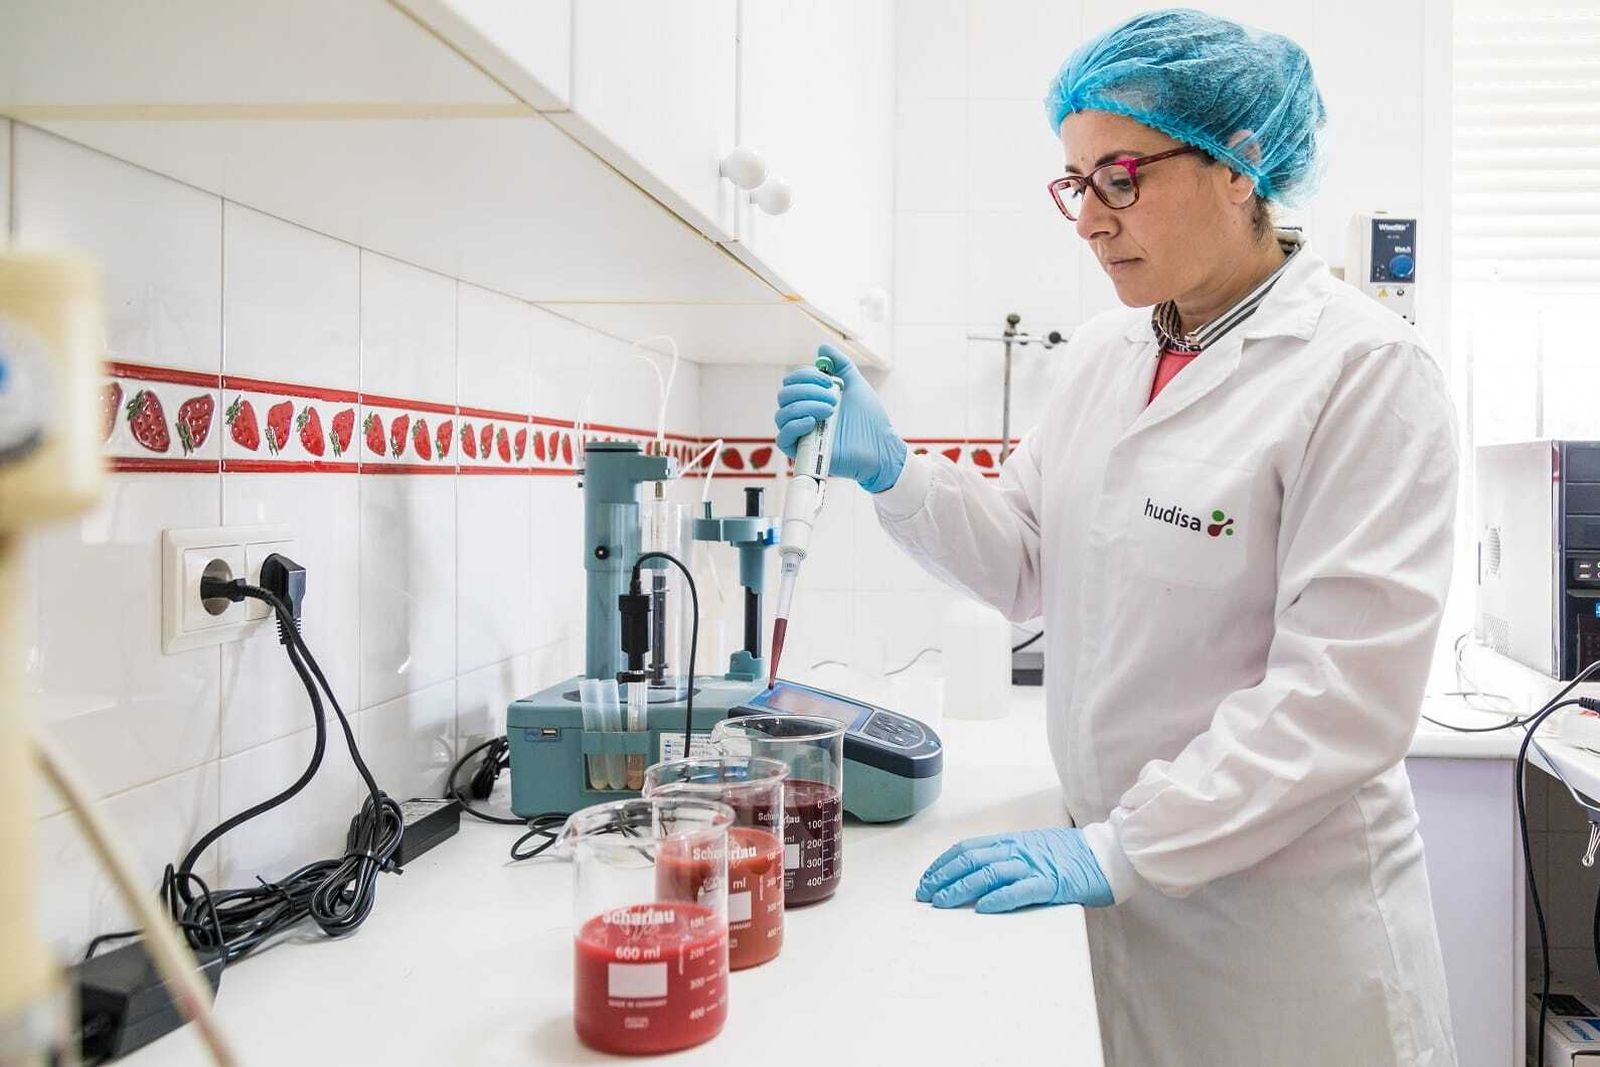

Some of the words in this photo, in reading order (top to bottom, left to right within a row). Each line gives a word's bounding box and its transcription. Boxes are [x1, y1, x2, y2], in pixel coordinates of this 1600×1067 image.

[1143, 497, 1202, 532] hudisa
[807, 820, 822, 830] 100
[806, 839, 822, 849] 200
[806, 858, 822, 869] 300
[733, 877, 746, 889] ml
[806, 877, 822, 887] 400
[616, 946, 641, 959] 600
[643, 945, 661, 958] ml
